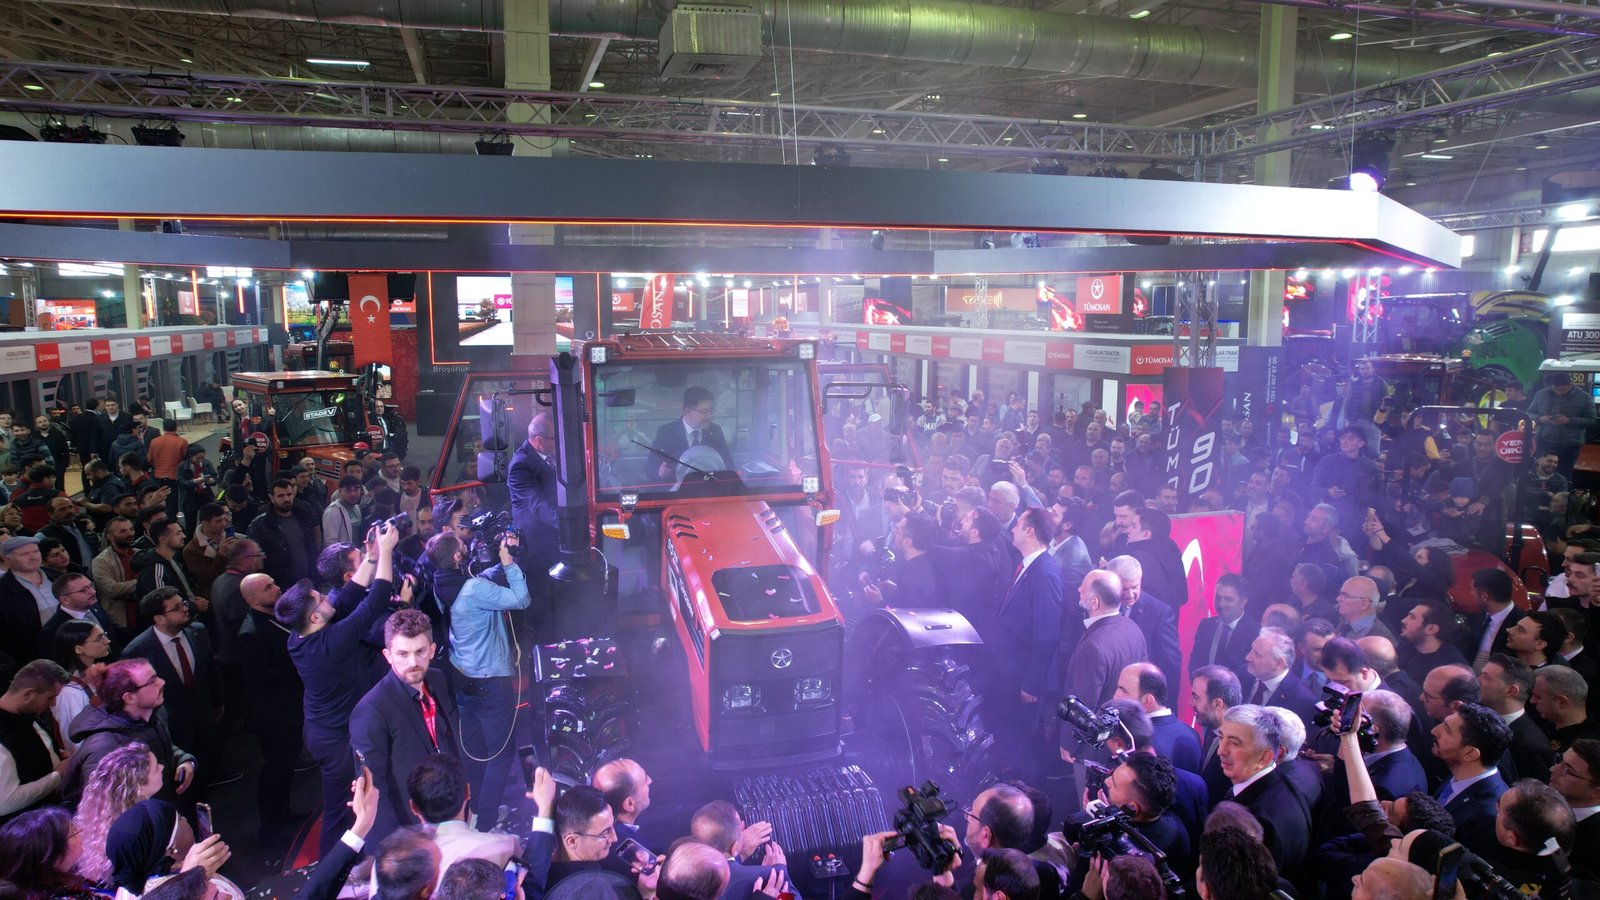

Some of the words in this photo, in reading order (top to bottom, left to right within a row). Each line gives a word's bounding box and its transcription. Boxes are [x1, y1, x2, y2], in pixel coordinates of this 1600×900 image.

[1084, 303, 1111, 312] TÜMOSAN
[1568, 331, 1583, 339] ATU
[1585, 331, 1600, 339] 300
[433, 365, 469, 373] Broşürlük
[1243, 392, 1252, 421] SAN
